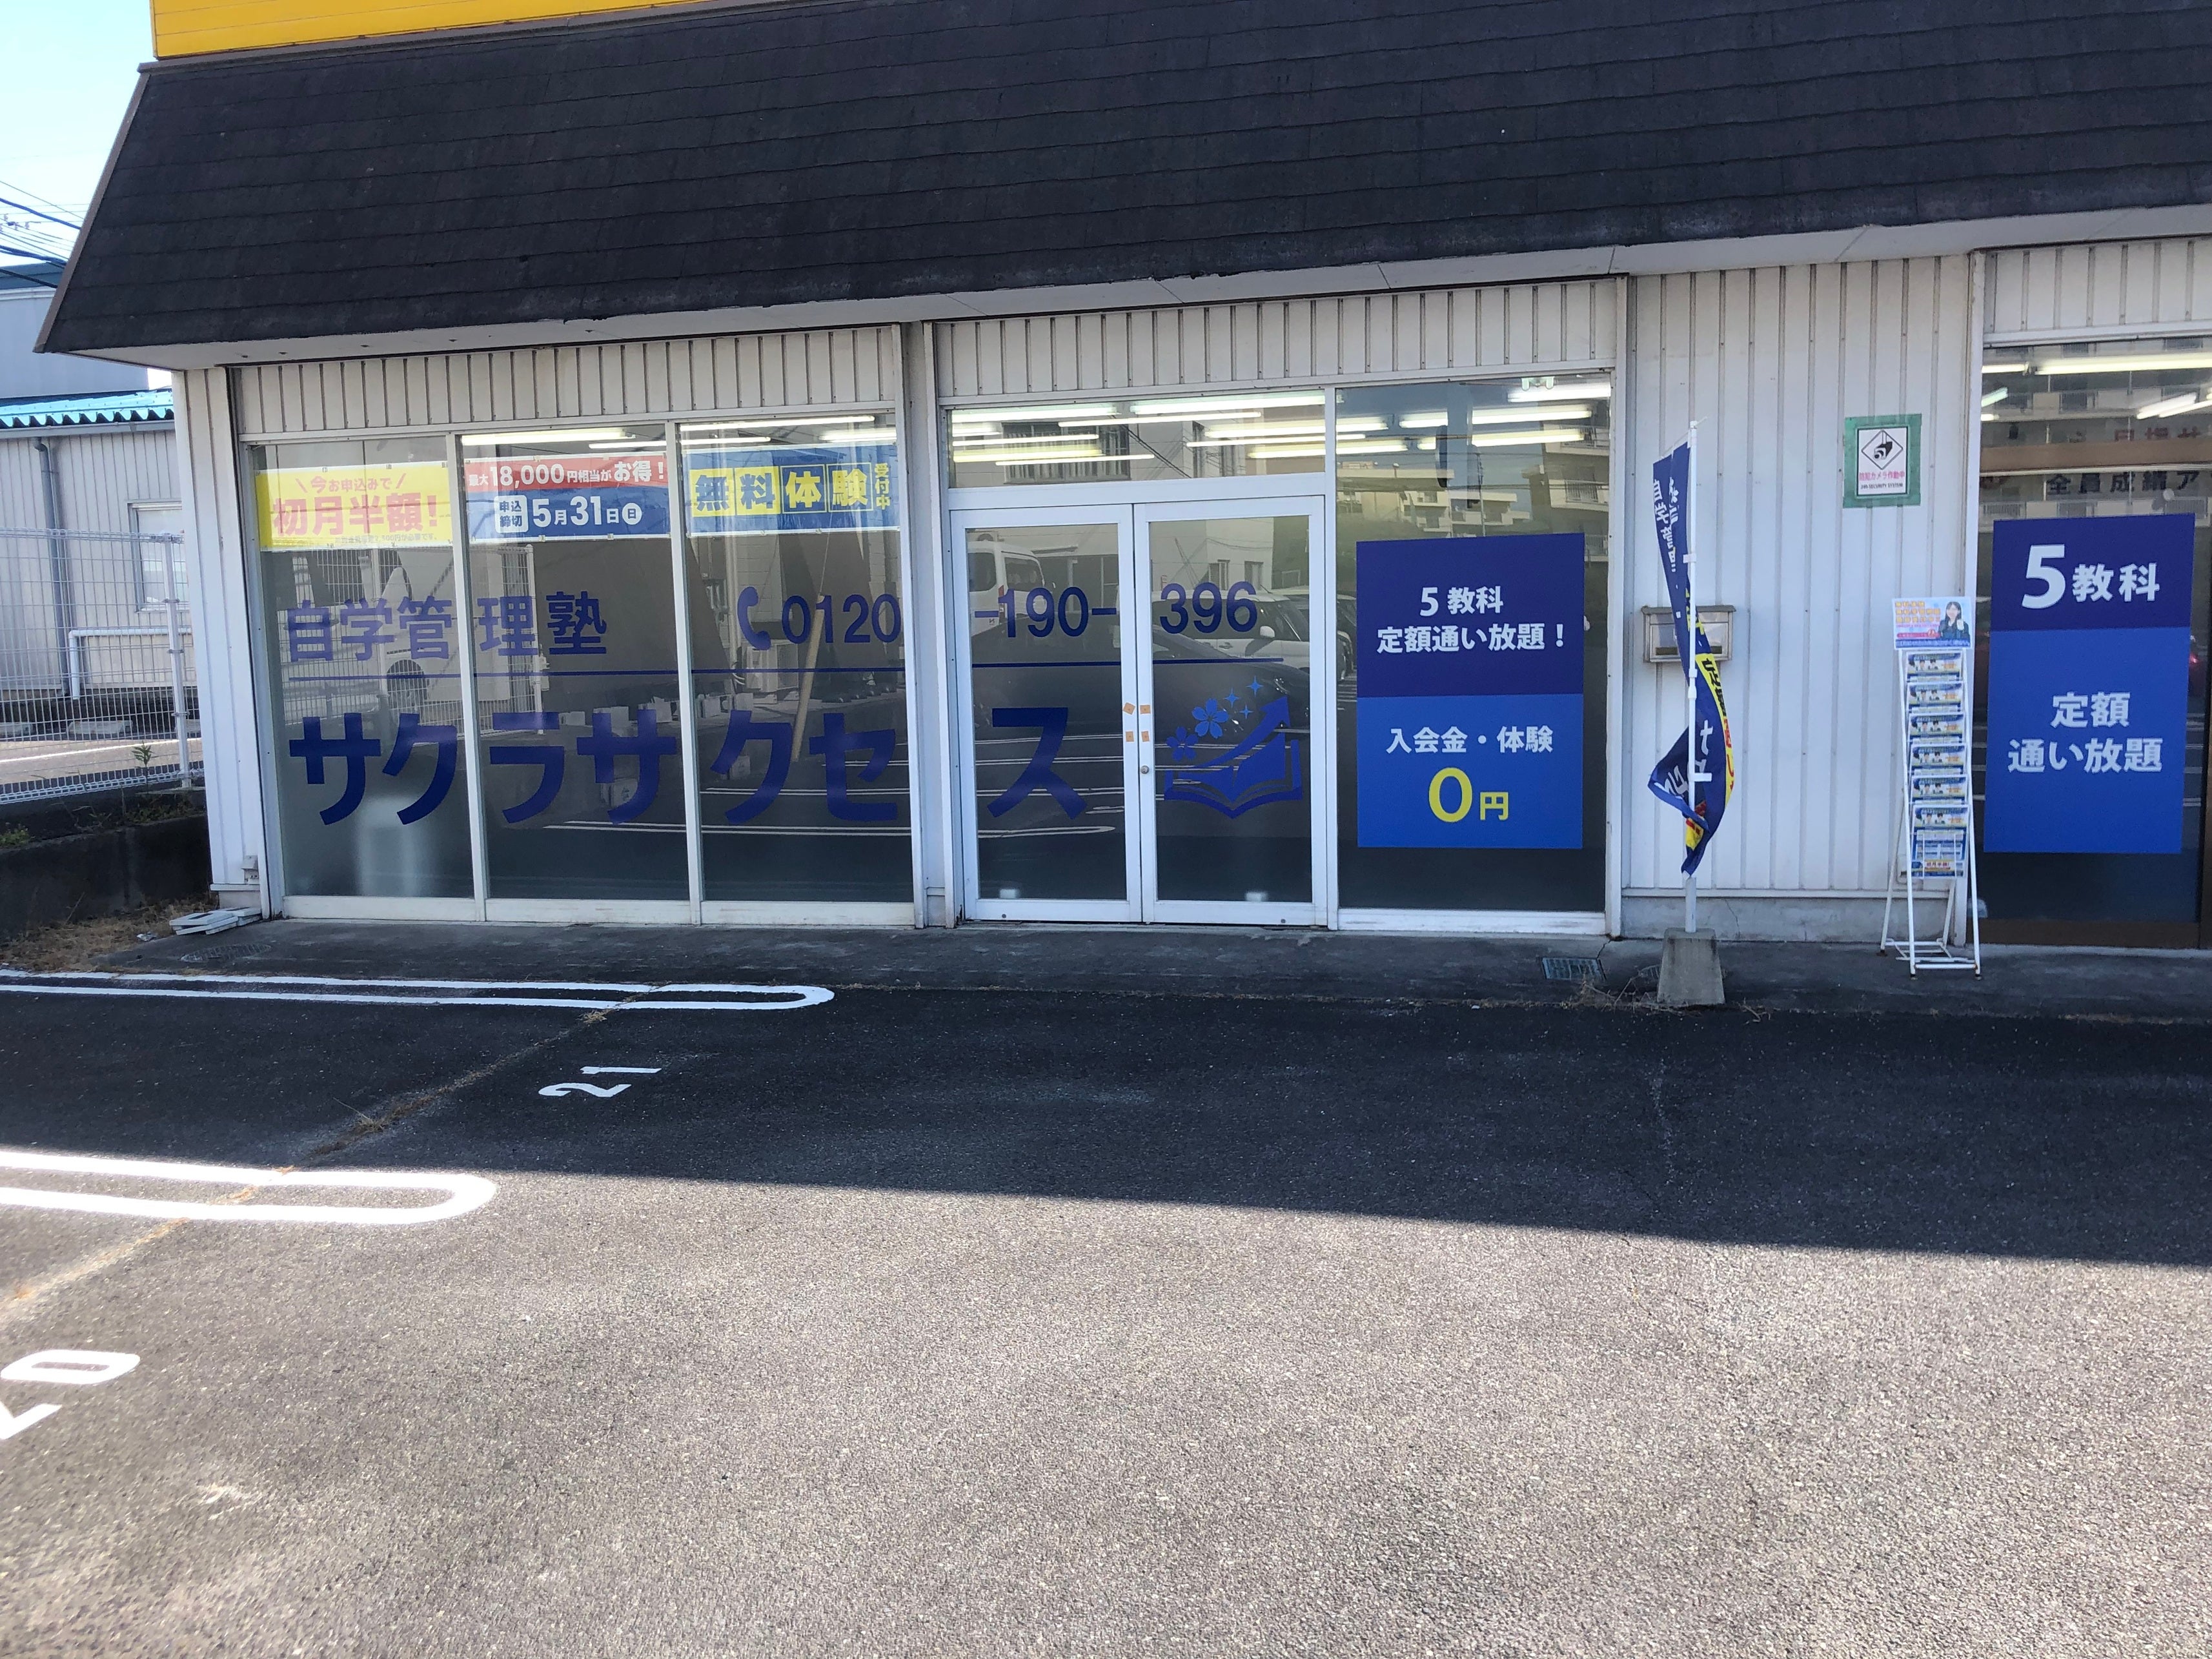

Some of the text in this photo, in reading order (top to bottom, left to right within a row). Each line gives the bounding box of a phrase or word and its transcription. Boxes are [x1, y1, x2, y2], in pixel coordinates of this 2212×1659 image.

[310, 475, 392, 494] 今お申込みで
[695, 468, 868, 511] 無料体験
[874, 462, 890, 510] 受付中
[2045, 471, 2212, 494] 全員成績ア
[499, 500, 522, 513] 申込
[500, 514, 522, 527] 締切
[2021, 544, 2160, 609] 5教科
[1419, 585, 1504, 616] 5教科
[288, 591, 607, 662] 自学管理塾
[2049, 691, 2131, 728] 定額
[1386, 726, 1554, 754] 入会金・体験
[2007, 737, 2164, 773] 通い放題
[289, 707, 1088, 826] サクラサクセス
[1428, 766, 1509, 822] 0円
